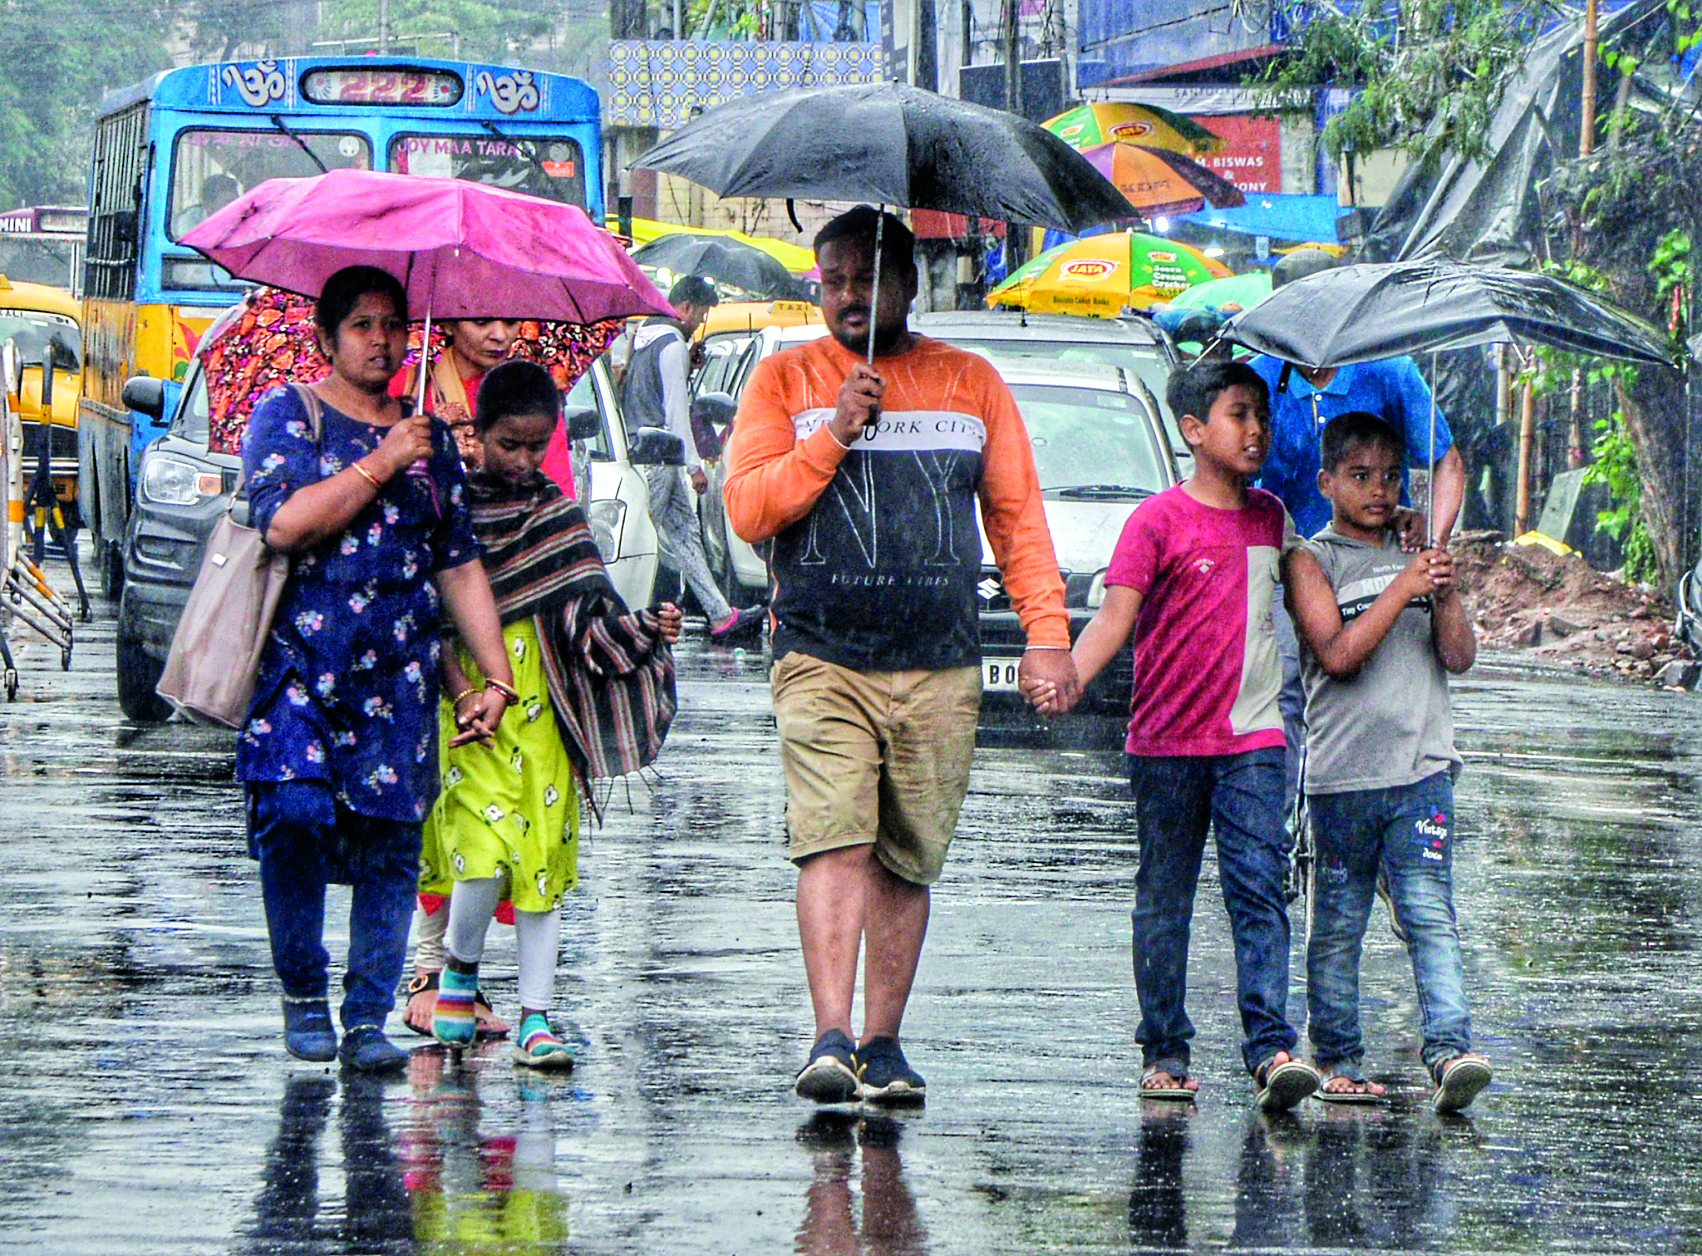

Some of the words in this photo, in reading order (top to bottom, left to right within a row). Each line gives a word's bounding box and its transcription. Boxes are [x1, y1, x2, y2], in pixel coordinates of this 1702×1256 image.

[339, 71, 429, 103] 222
[397, 138, 431, 153] JOY
[434, 139, 473, 155] MAA
[476, 140, 518, 156] TARA
[1213, 156, 1264, 168] BISWAS
[1223, 170, 1235, 180] &
[1070, 263, 1104, 274] JAYA
[778, 303, 809, 311] TAXI
[876, 420, 922, 434] ORK
